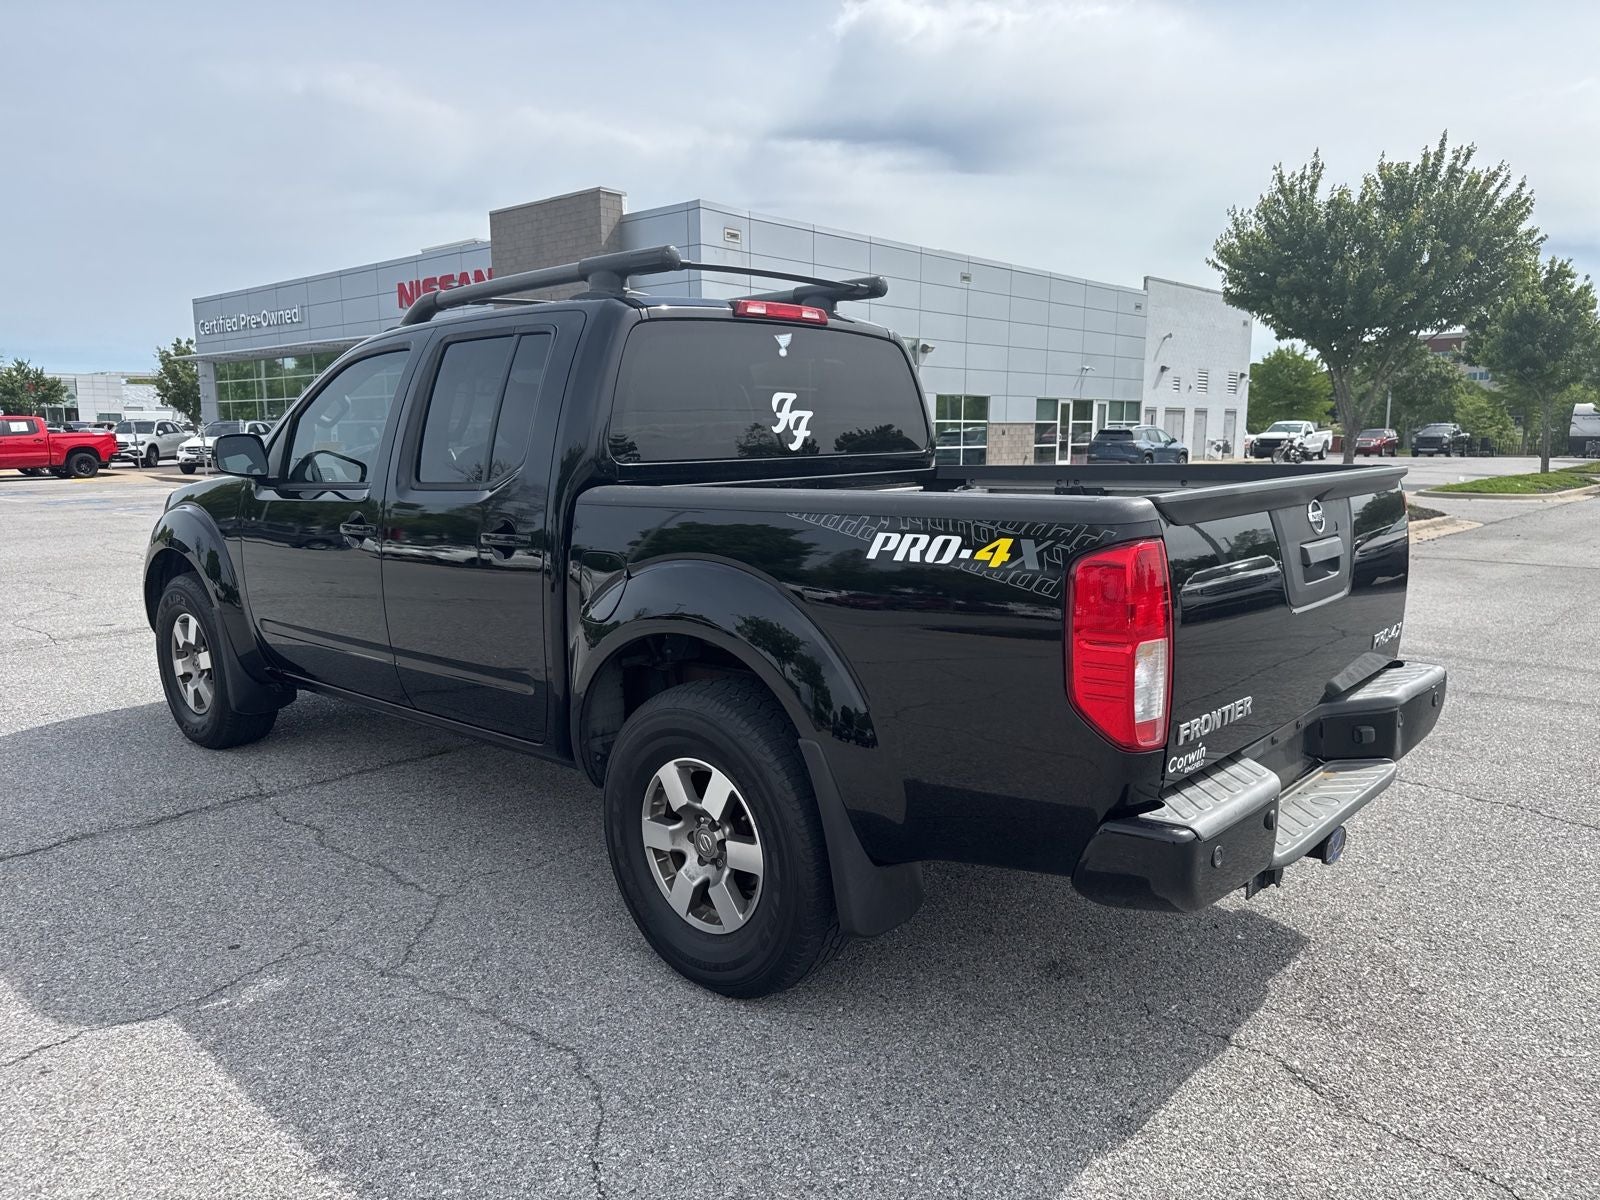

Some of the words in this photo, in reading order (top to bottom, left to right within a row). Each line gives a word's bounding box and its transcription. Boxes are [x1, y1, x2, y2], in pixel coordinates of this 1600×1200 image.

[199, 313, 238, 335] Certified
[240, 304, 300, 331] Pre-Owned
[866, 531, 1055, 571] PRO-4X
[1178, 696, 1253, 746] FRONTIER
[1168, 742, 1206, 773] Corwin
